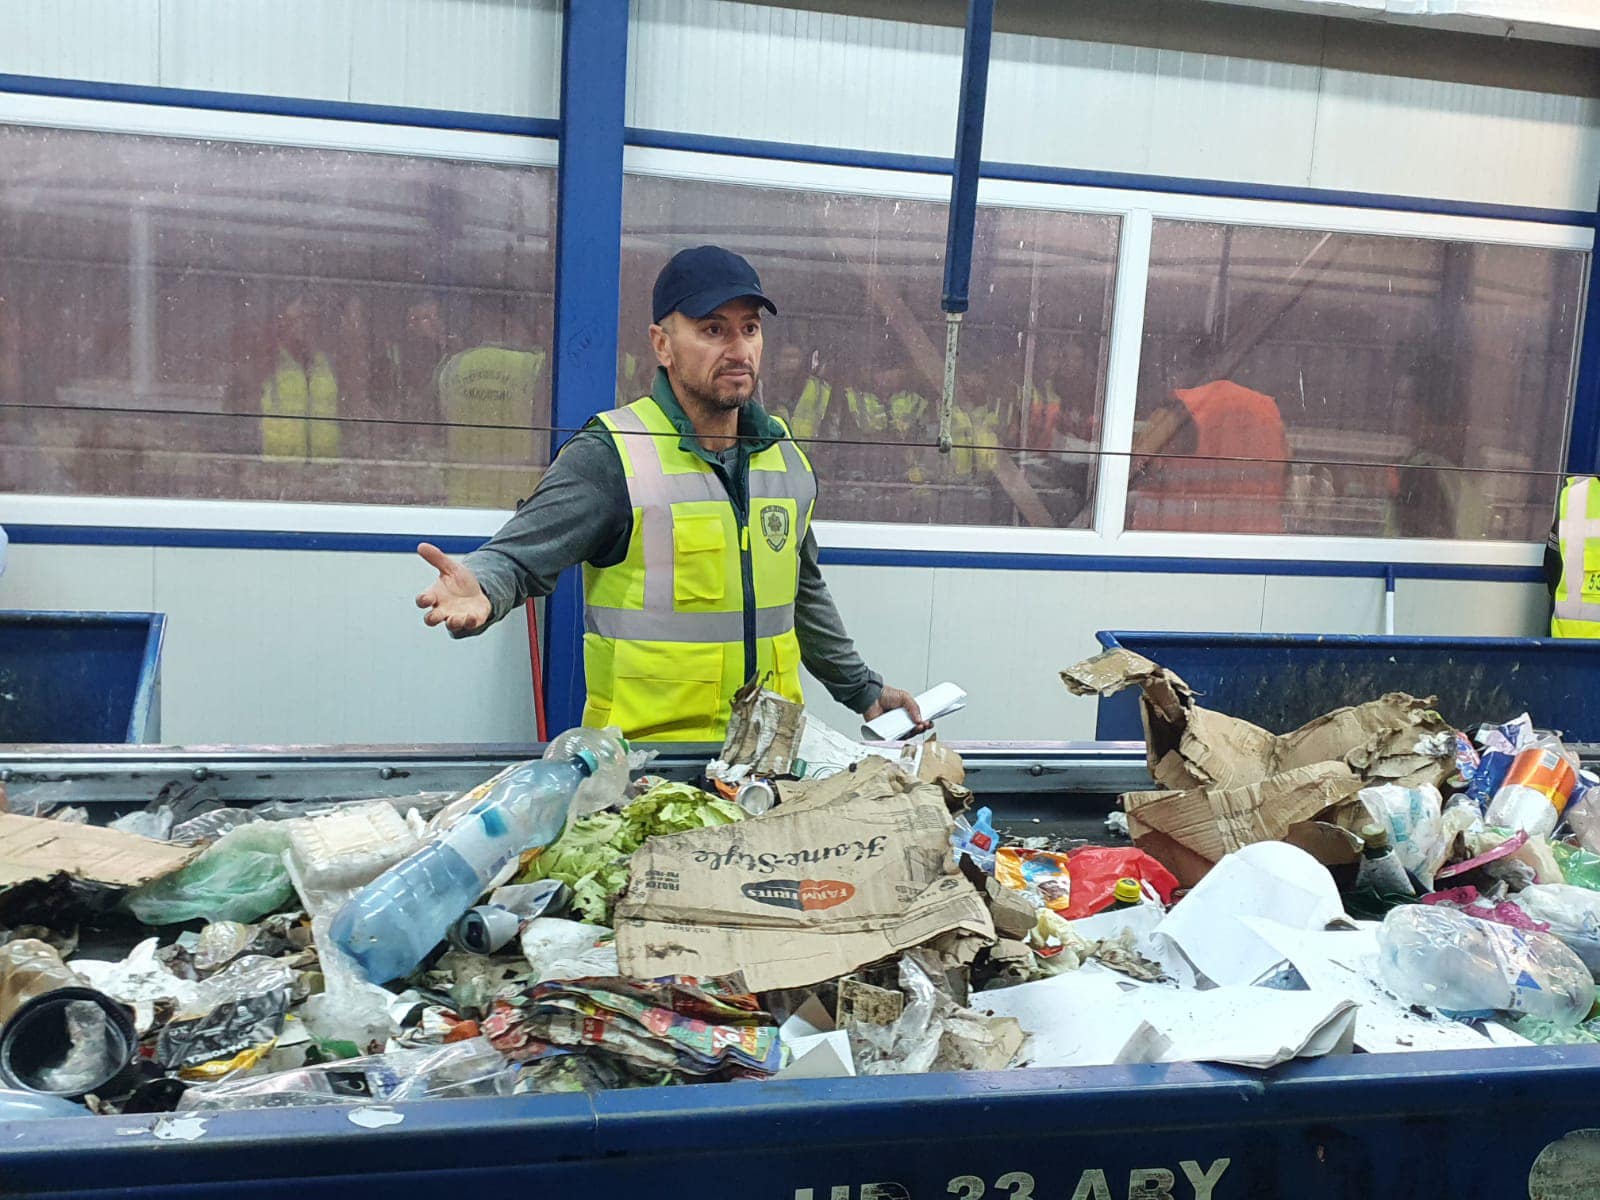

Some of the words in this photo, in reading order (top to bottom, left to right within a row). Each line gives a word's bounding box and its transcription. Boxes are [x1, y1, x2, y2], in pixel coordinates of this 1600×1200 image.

[693, 836, 887, 874] Home-Style
[747, 889, 798, 902] FRITES
[802, 887, 848, 901] FARM
